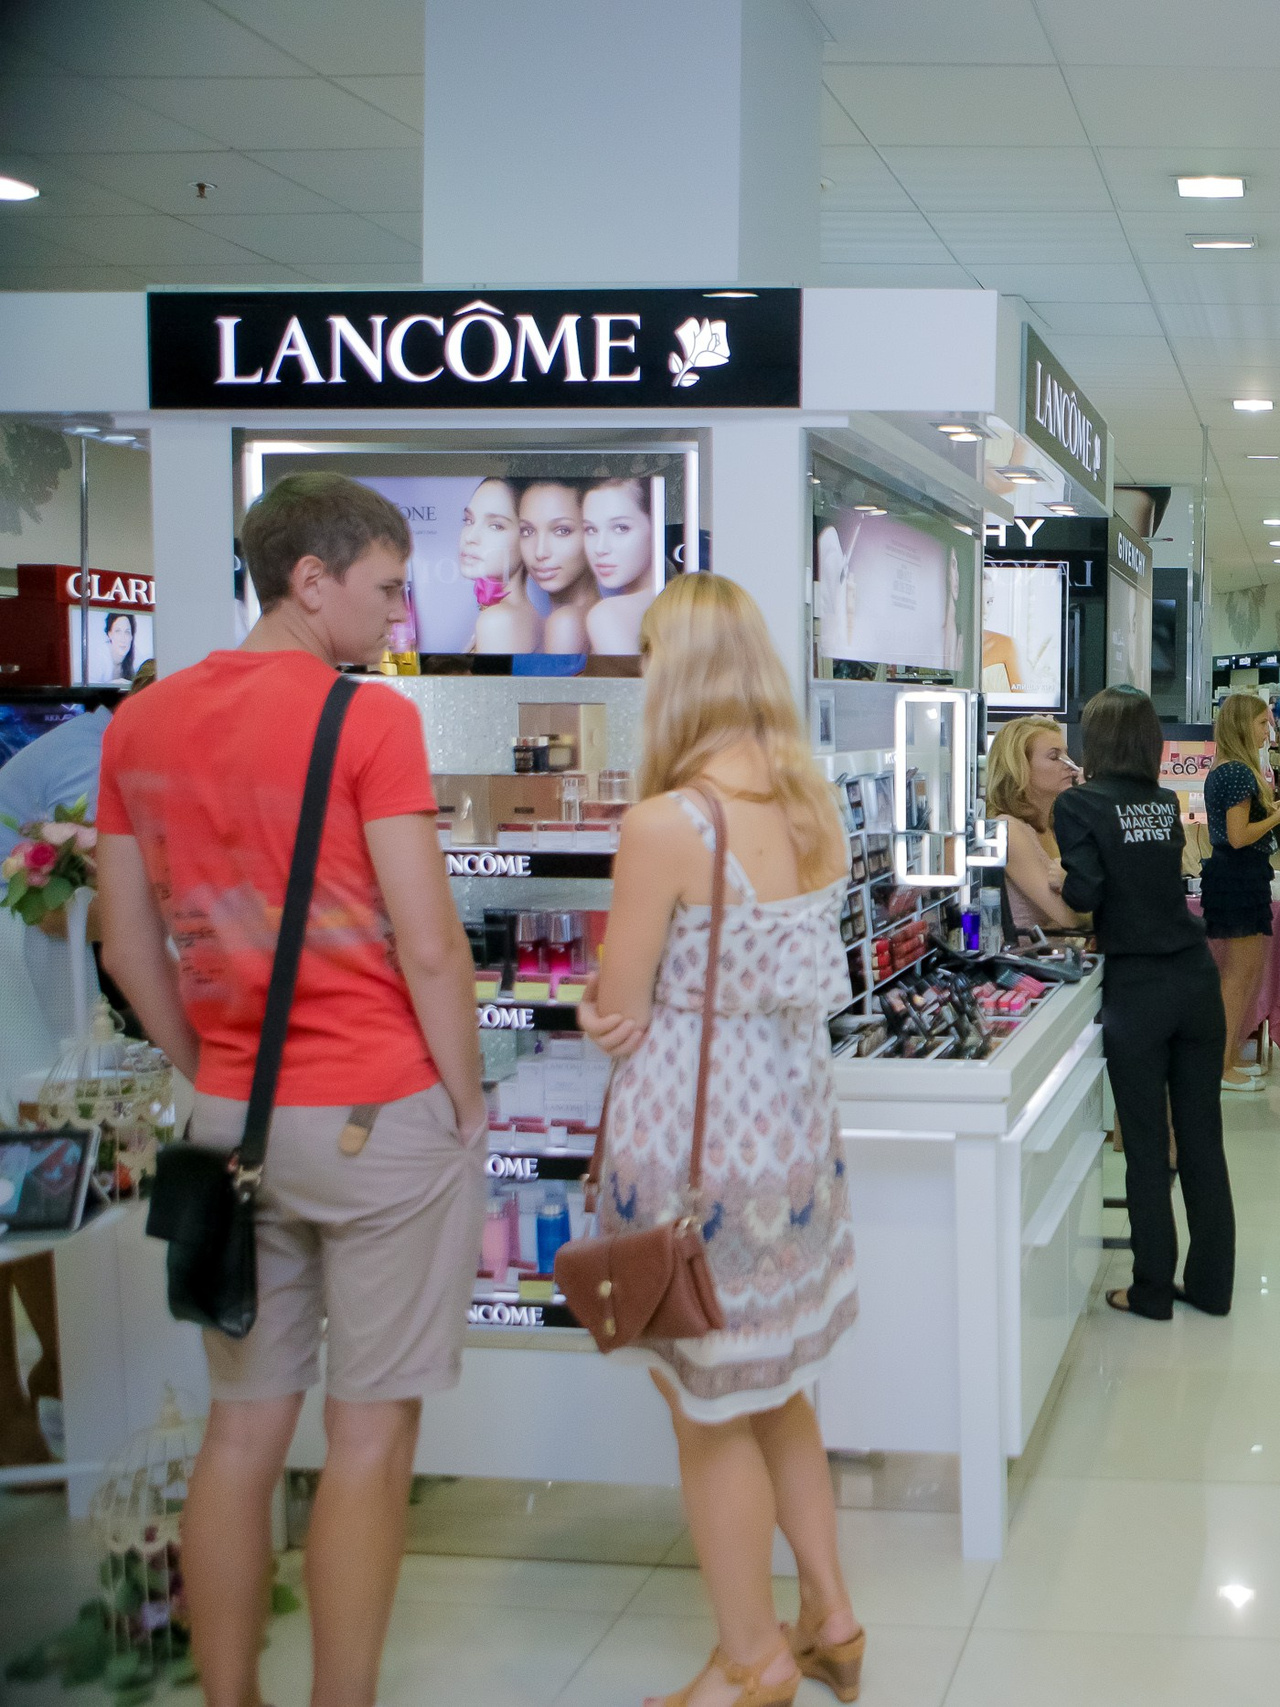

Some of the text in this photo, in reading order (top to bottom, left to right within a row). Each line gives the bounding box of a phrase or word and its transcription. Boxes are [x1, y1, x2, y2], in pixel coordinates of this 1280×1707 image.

[213, 299, 642, 386] LANCÔME
[1035, 360, 1093, 472] LANCÔME
[1117, 531, 1146, 578] GIVENCHY
[1115, 802, 1177, 817] LANCÔME
[1120, 816, 1174, 830] MAKE-UP
[1124, 828, 1171, 844] ARTIST
[476, 1004, 535, 1030] ÔME
